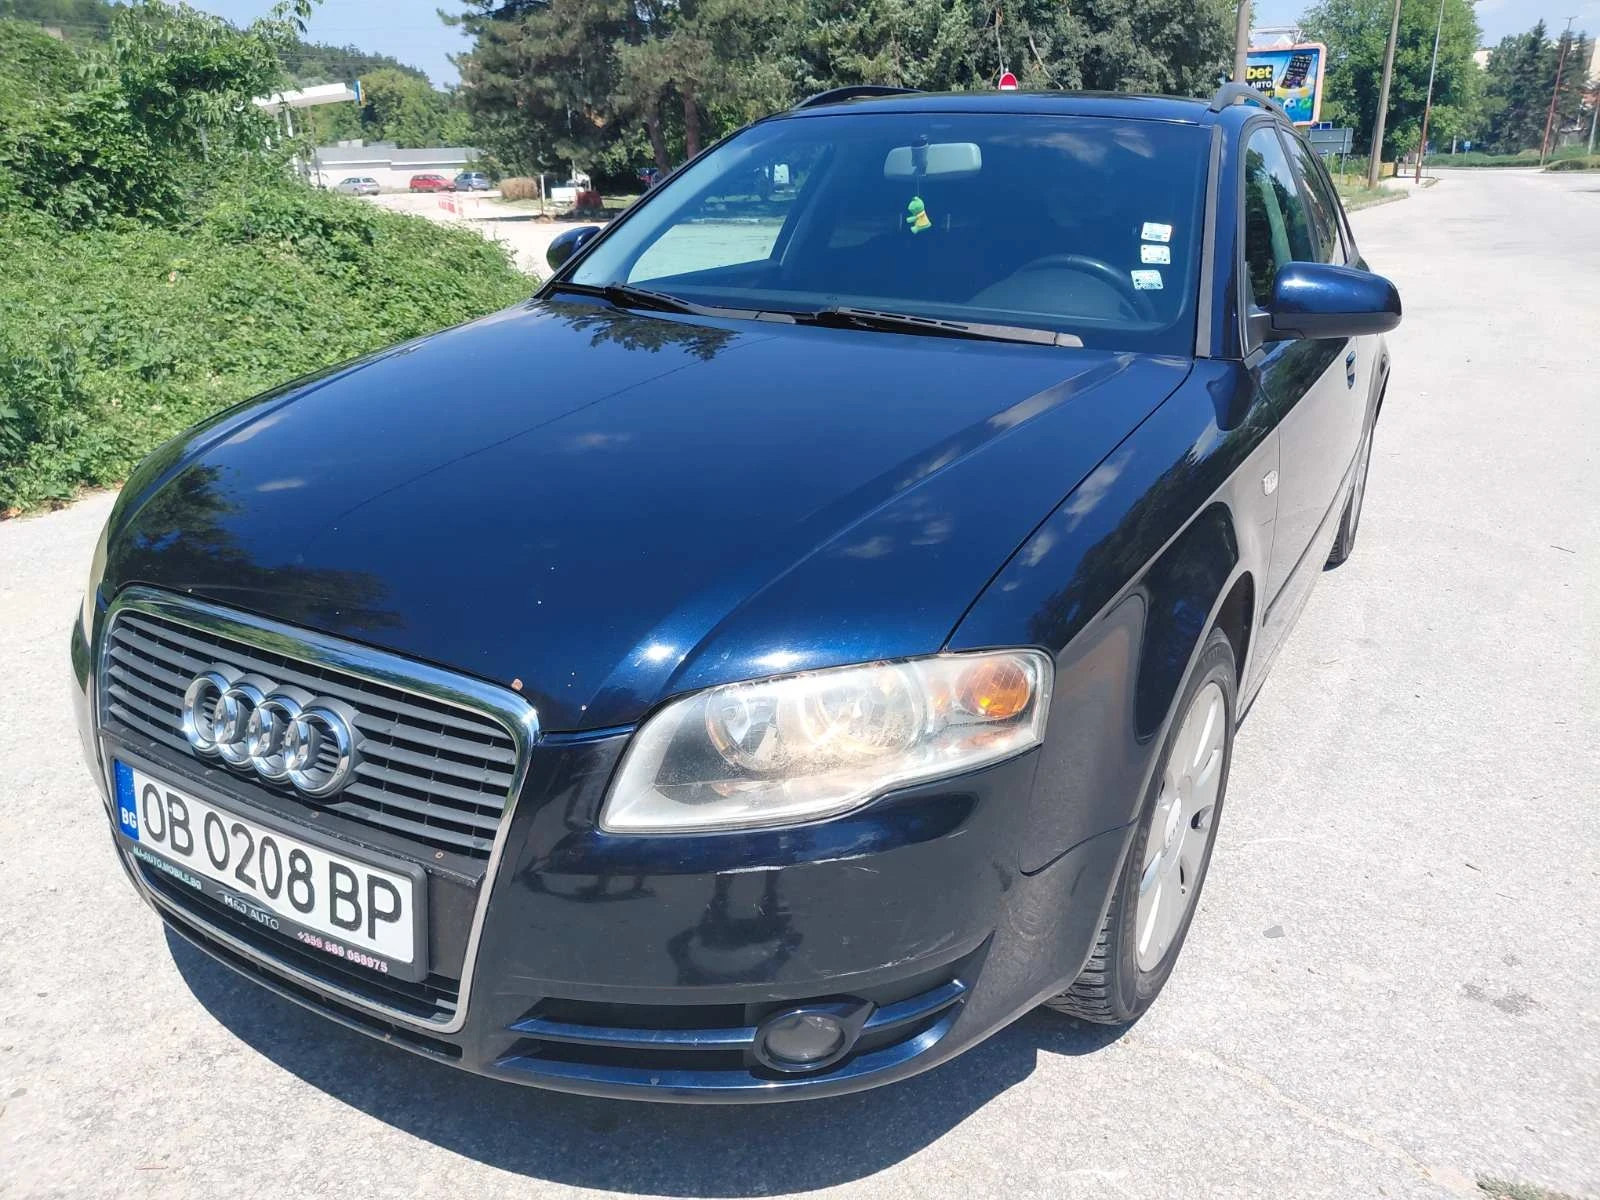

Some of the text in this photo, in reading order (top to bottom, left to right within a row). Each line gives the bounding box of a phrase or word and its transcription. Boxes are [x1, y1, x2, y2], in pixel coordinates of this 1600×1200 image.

[121, 807, 137, 829] BG
[142, 783, 402, 940] OB 0208 BP
[250, 909, 279, 930] AUTO
